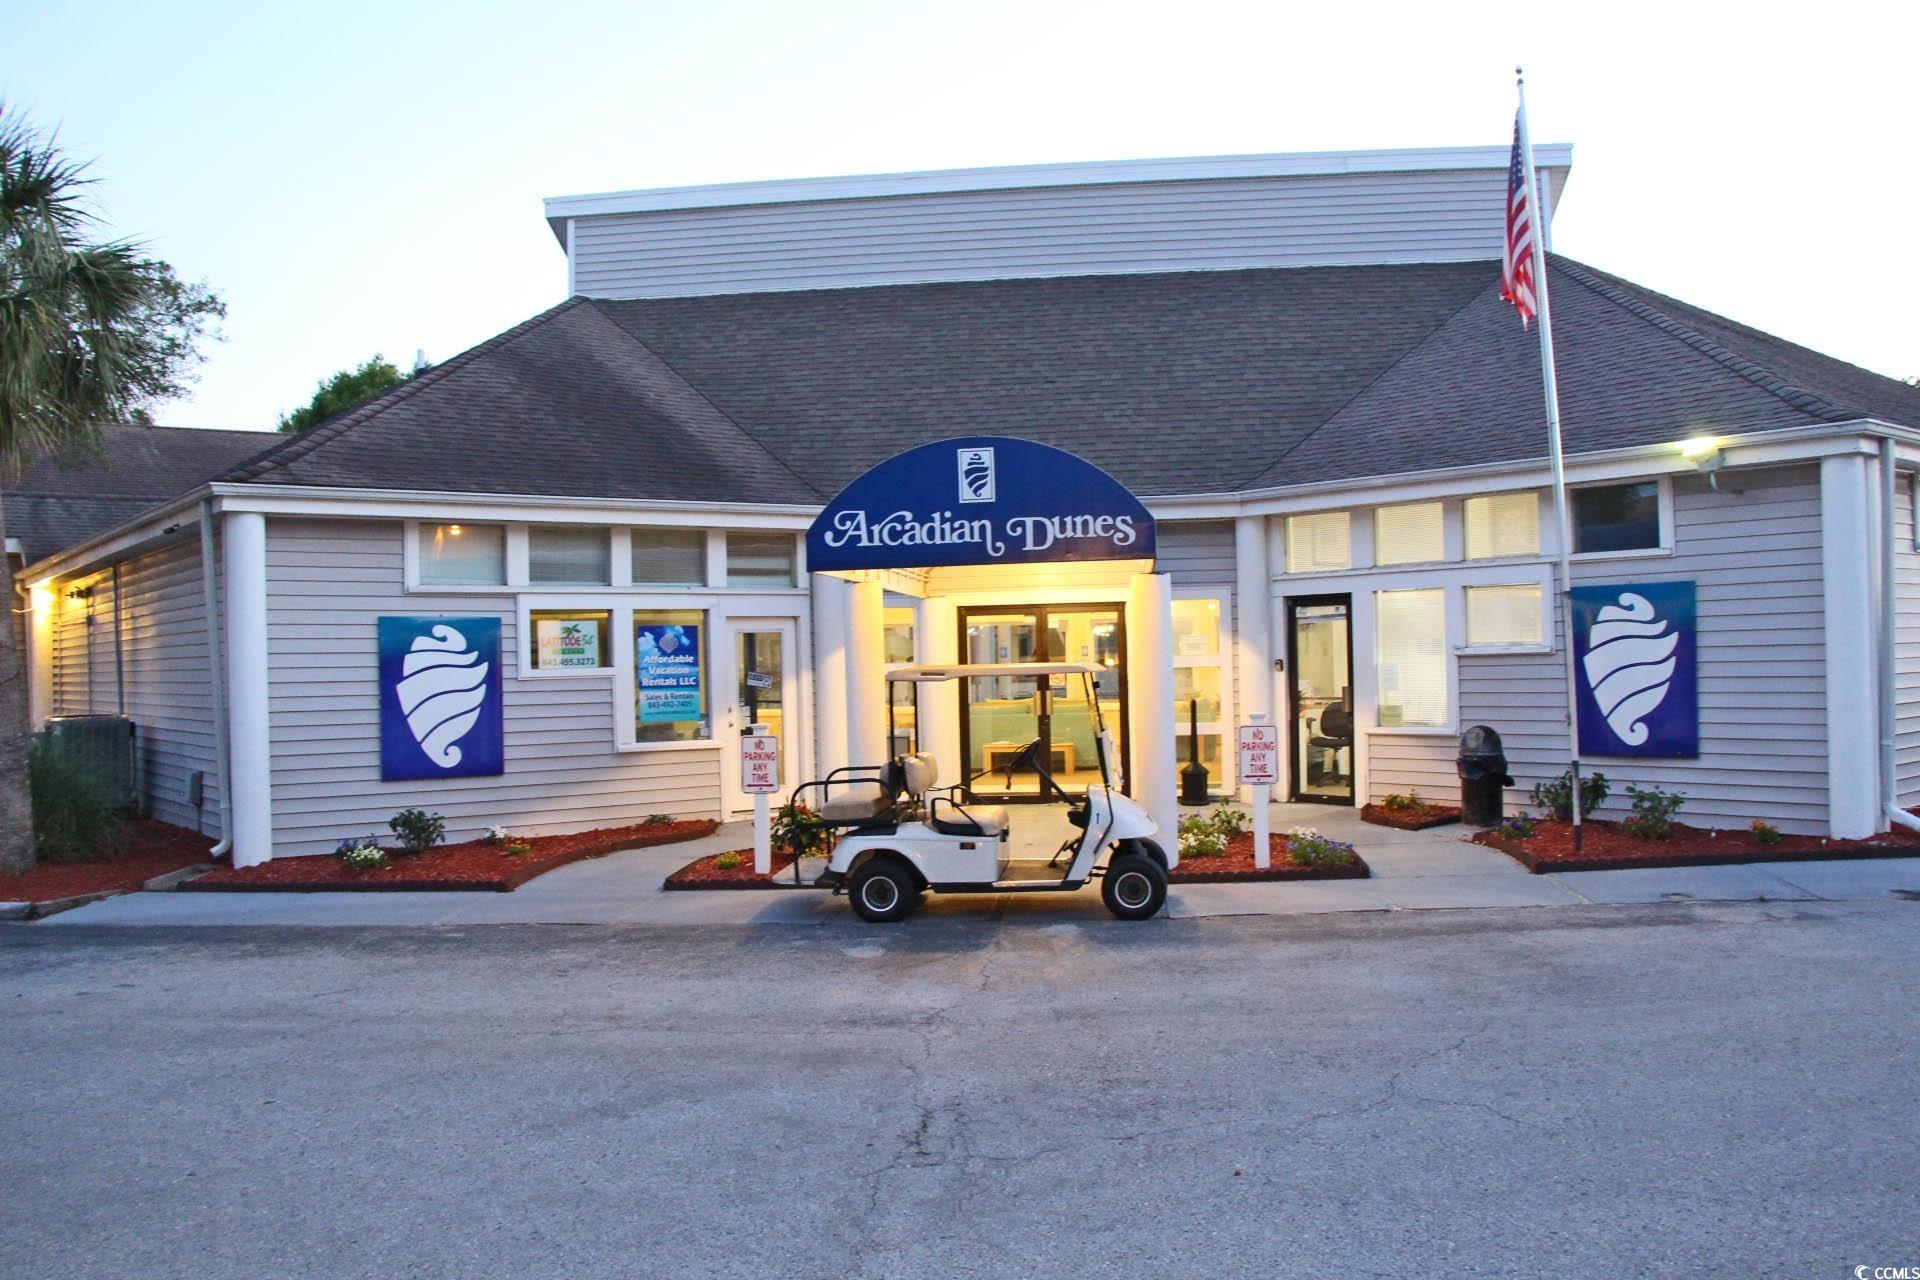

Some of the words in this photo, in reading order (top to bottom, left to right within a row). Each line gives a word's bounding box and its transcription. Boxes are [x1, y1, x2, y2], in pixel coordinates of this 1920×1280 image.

[824, 510, 1004, 556] Arcadian
[1006, 514, 1137, 550] Dunes
[643, 655, 694, 664] Affordable
[648, 666, 689, 675] Vacation
[642, 677, 678, 687] Rentals
[679, 676, 697, 686] LLC
[645, 693, 662, 701] Sales
[1252, 728, 1263, 740] NO
[754, 739, 765, 750] NO
[1242, 742, 1274, 750] PARKING
[744, 752, 775, 760] PARKING
[1251, 753, 1266, 762] ANY
[753, 763, 768, 772] ANY
[1250, 763, 1267, 773] TIME
[752, 773, 768, 782] TIME
